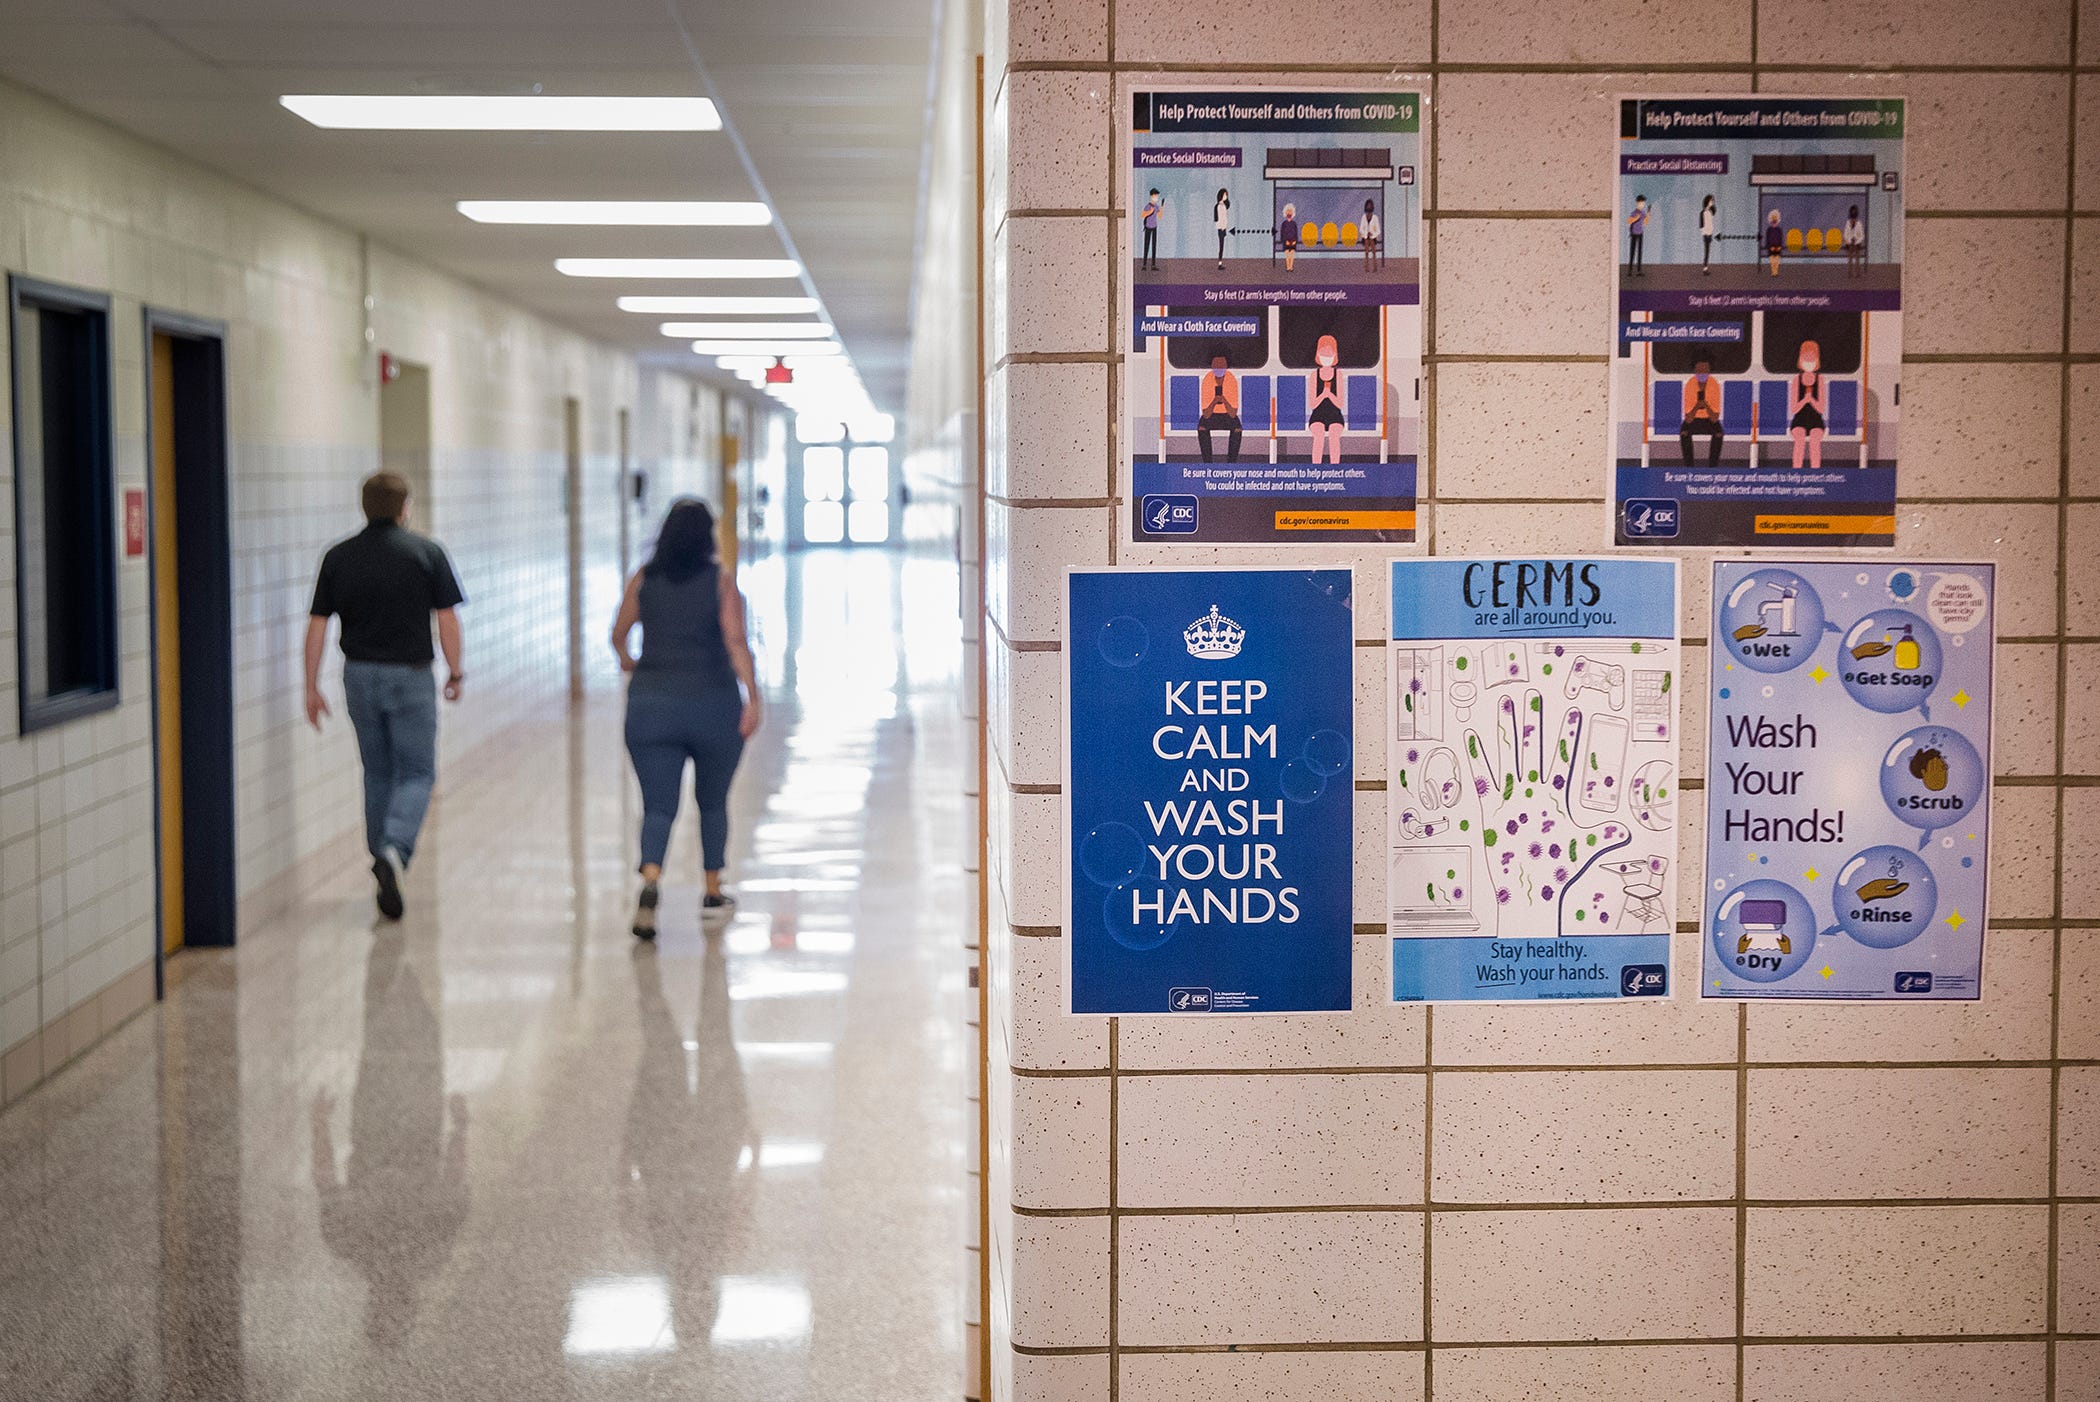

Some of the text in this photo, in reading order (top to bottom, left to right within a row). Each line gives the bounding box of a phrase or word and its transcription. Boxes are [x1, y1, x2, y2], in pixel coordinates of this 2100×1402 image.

[1159, 103, 1412, 122] Help Protect Yourself and Others from COVID-19
[1141, 152, 1236, 166] Practice Social Distancing
[1204, 290, 1218, 301] Stay
[1219, 290, 1224, 300] 6
[1224, 290, 1237, 300] feet
[1290, 290, 1306, 300] from
[1306, 290, 1323, 300] other
[1141, 321, 1256, 335] And Wear a Cloth Face Covering
[1183, 468, 1191, 478] Be
[1192, 470, 1206, 478] sure
[1213, 470, 1232, 478] covers
[1233, 470, 1247, 480] your
[1248, 470, 1263, 478] nose
[1264, 468, 1276, 478] and
[1277, 468, 1298, 478] mouth
[1299, 469, 1306, 478] to
[1307, 468, 1321, 480] help
[1321, 469, 1344, 480] protect
[1205, 481, 1217, 490] You
[1218, 481, 1235, 490] could
[1236, 481, 1243, 490] be
[1245, 481, 1270, 490] infected
[1271, 481, 1283, 490] and
[1284, 482, 1295, 490] not
[1296, 481, 1311, 490] have
[1173, 508, 1193, 518] CDC
[1280, 517, 1350, 526] cdc.gov/coronavirus
[1463, 561, 1601, 609] GERMS
[1474, 608, 1617, 628] are all around you.
[1753, 643, 1791, 657] Wet
[1856, 672, 1887, 685] Get
[1891, 672, 1933, 689] Soap
[1165, 680, 1268, 716] KEEP
[1726, 714, 1817, 748] Wash
[1152, 724, 1277, 760] CALM
[1179, 768, 1250, 792] AND
[1726, 762, 1804, 795] Your
[1909, 795, 1963, 809] Scrub
[1143, 799, 1284, 836] WASH
[1725, 808, 1844, 842] Hands!
[1148, 843, 1282, 880] YOUR
[1132, 886, 1300, 924] HANDS
[1862, 907, 1912, 922] Rinse
[1491, 941, 1587, 962] Stay healthy.
[1748, 954, 1782, 972] Dry
[1476, 964, 1609, 985] Wash your hands.
[1645, 975, 1662, 983] CDC
